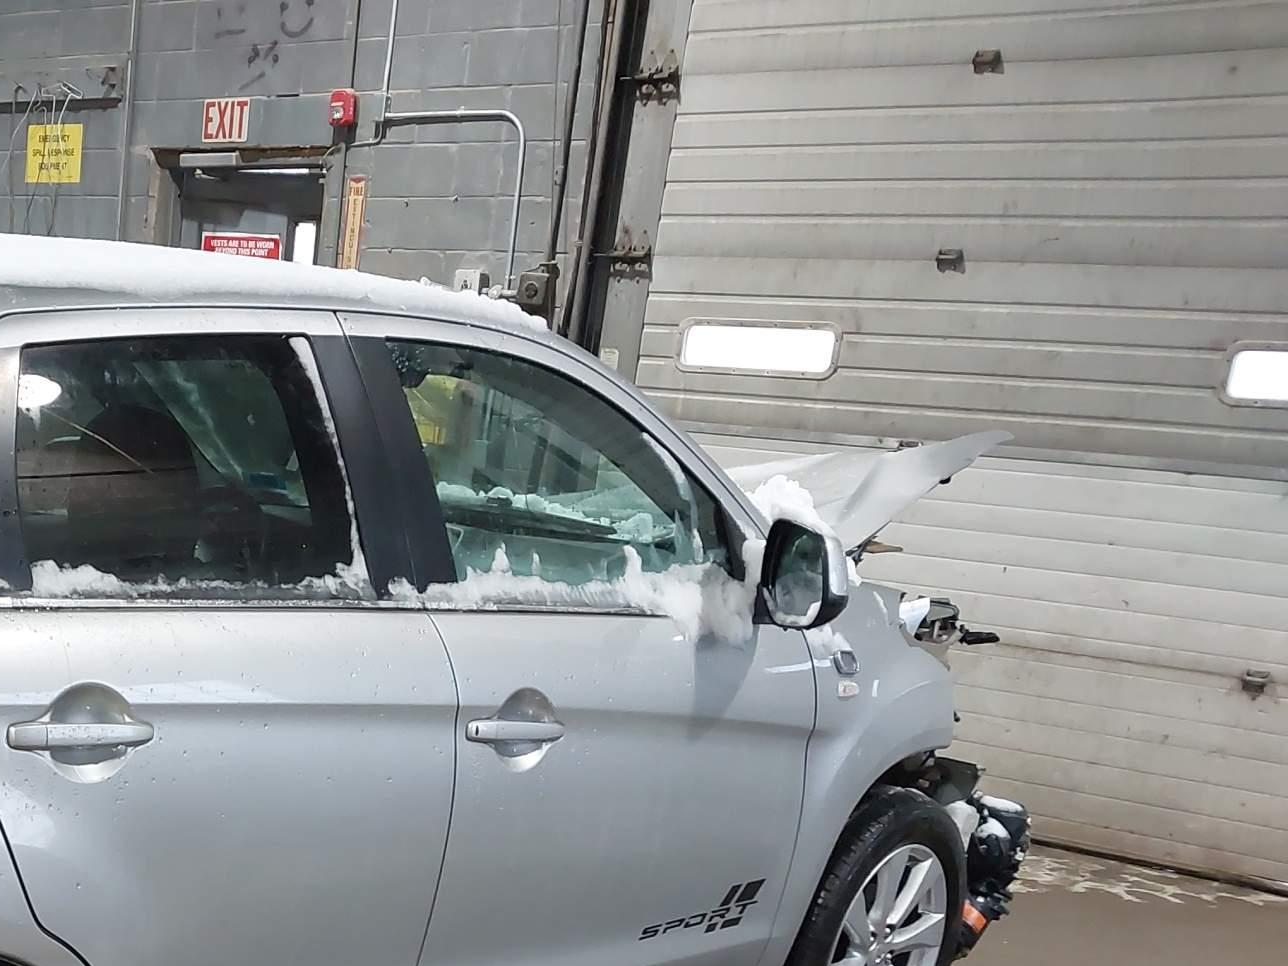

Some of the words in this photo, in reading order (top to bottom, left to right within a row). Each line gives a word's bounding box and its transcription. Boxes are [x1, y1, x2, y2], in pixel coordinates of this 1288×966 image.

[204, 101, 248, 139] EXIT
[48, 148, 74, 156] ESPNSE
[349, 186, 363, 196] FIRE
[240, 240, 248, 248] TO
[249, 240, 256, 248] BE
[257, 241, 274, 249] WORN
[215, 247, 237, 255] BEYOND
[238, 248, 250, 256] THIS
[638, 900, 758, 941] SPORT
